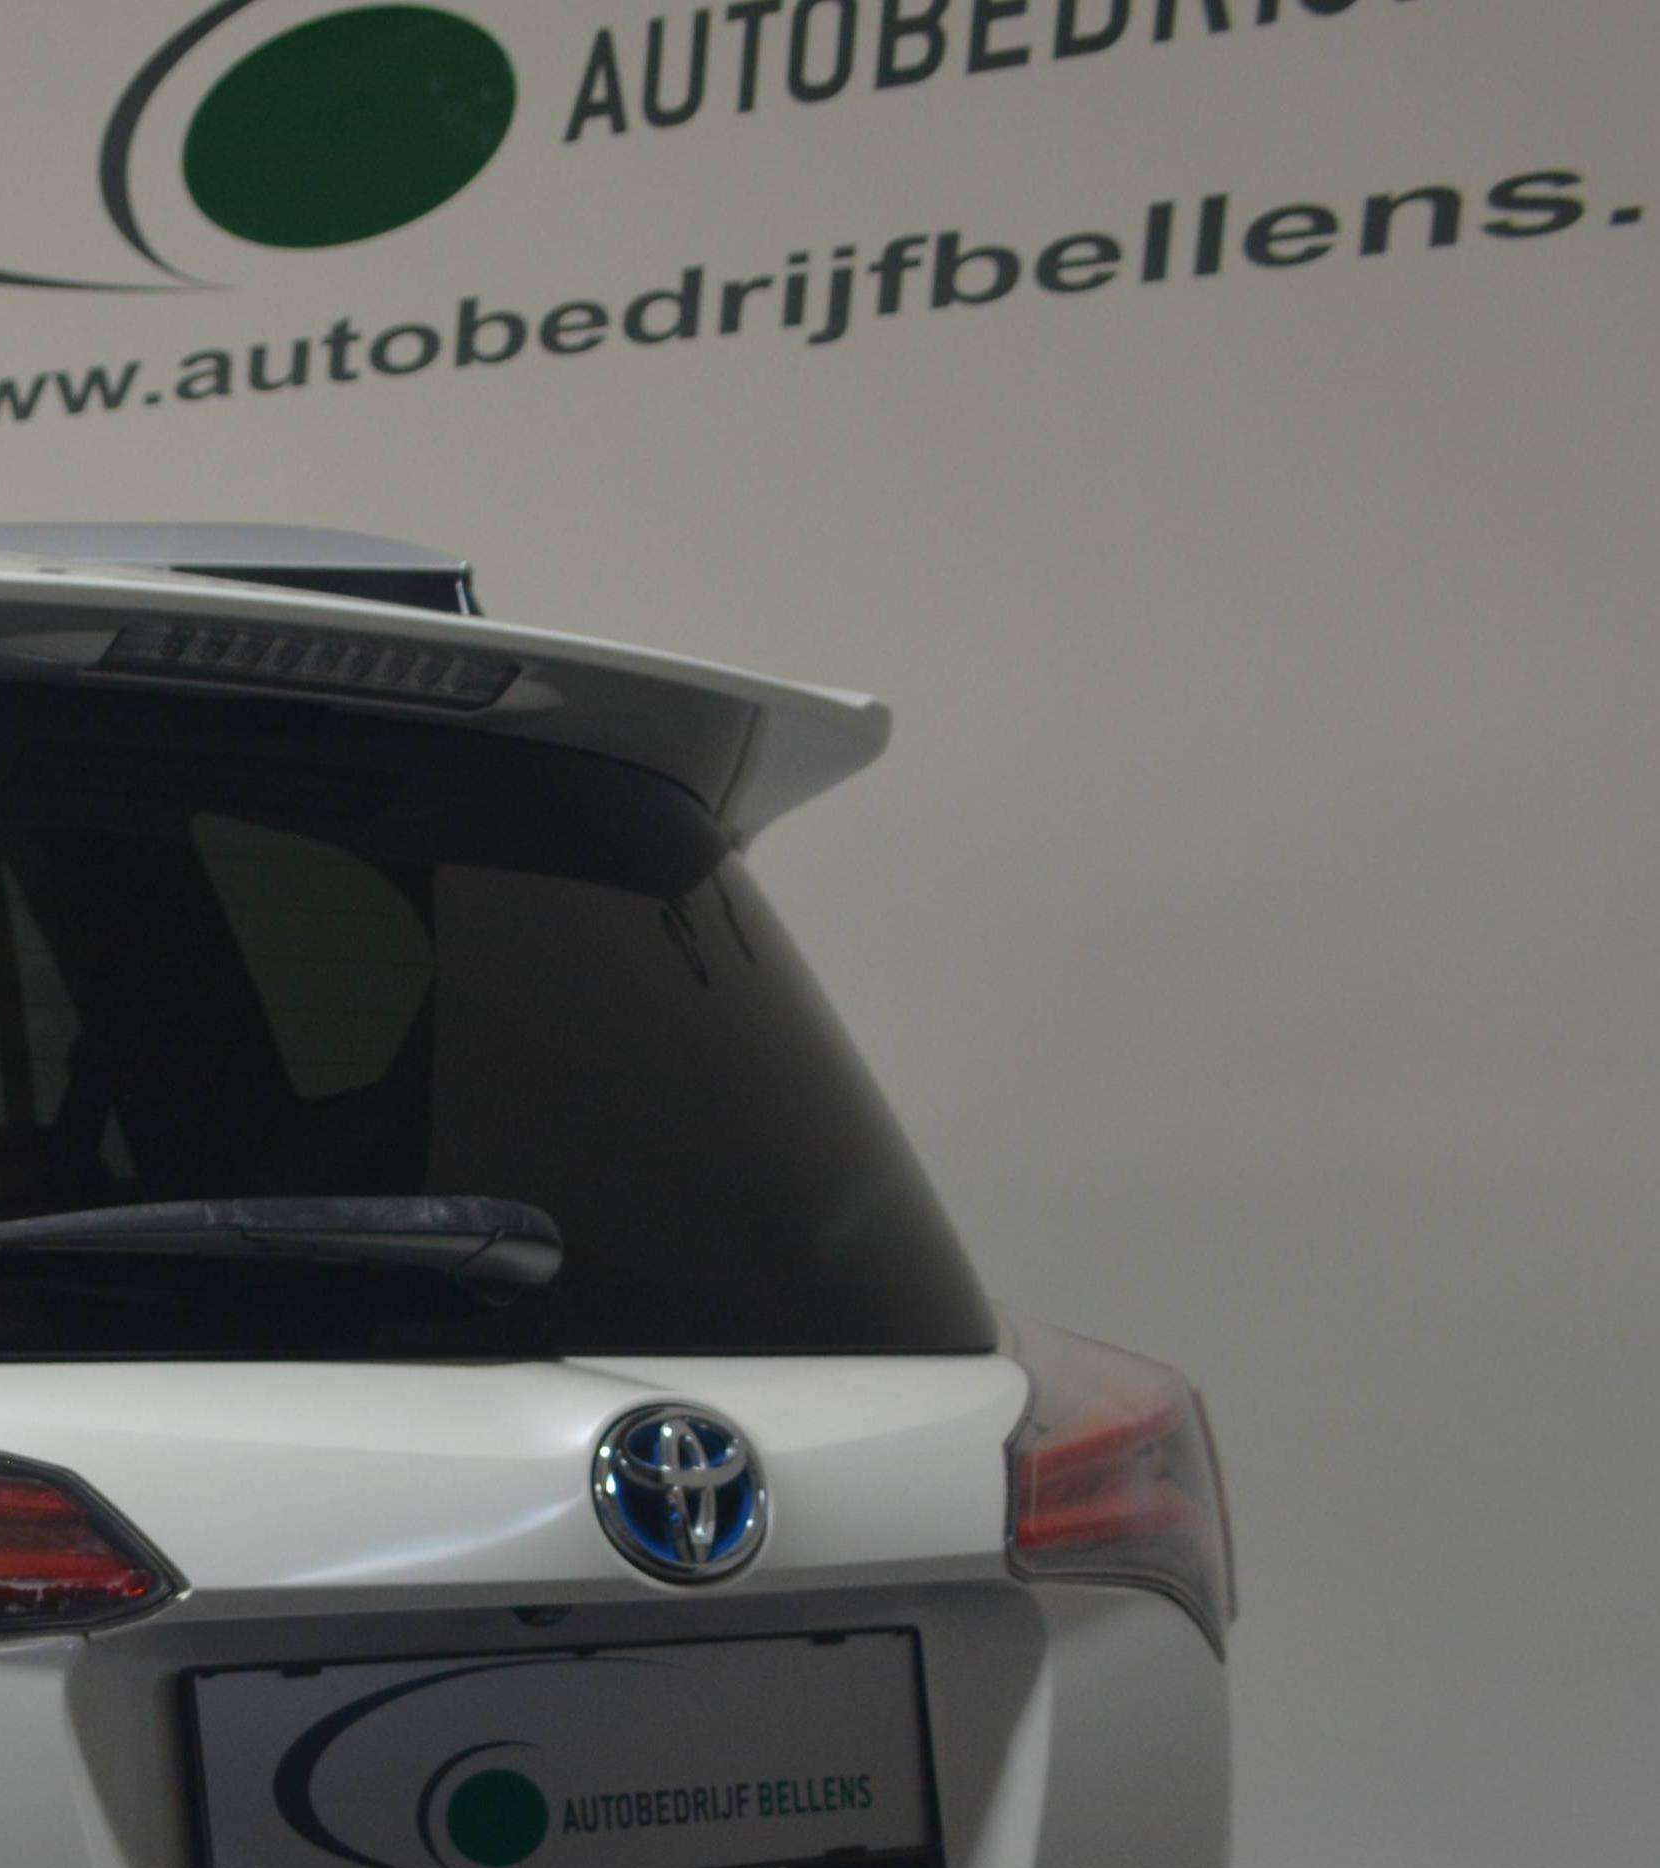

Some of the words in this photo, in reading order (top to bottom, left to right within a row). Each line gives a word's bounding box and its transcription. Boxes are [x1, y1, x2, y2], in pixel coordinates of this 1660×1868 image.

[563, 0, 1416, 142] AUTOBED
[562, 1783, 750, 1834] AUTOBEDRIJF
[759, 1774, 873, 1816] BELLENS
